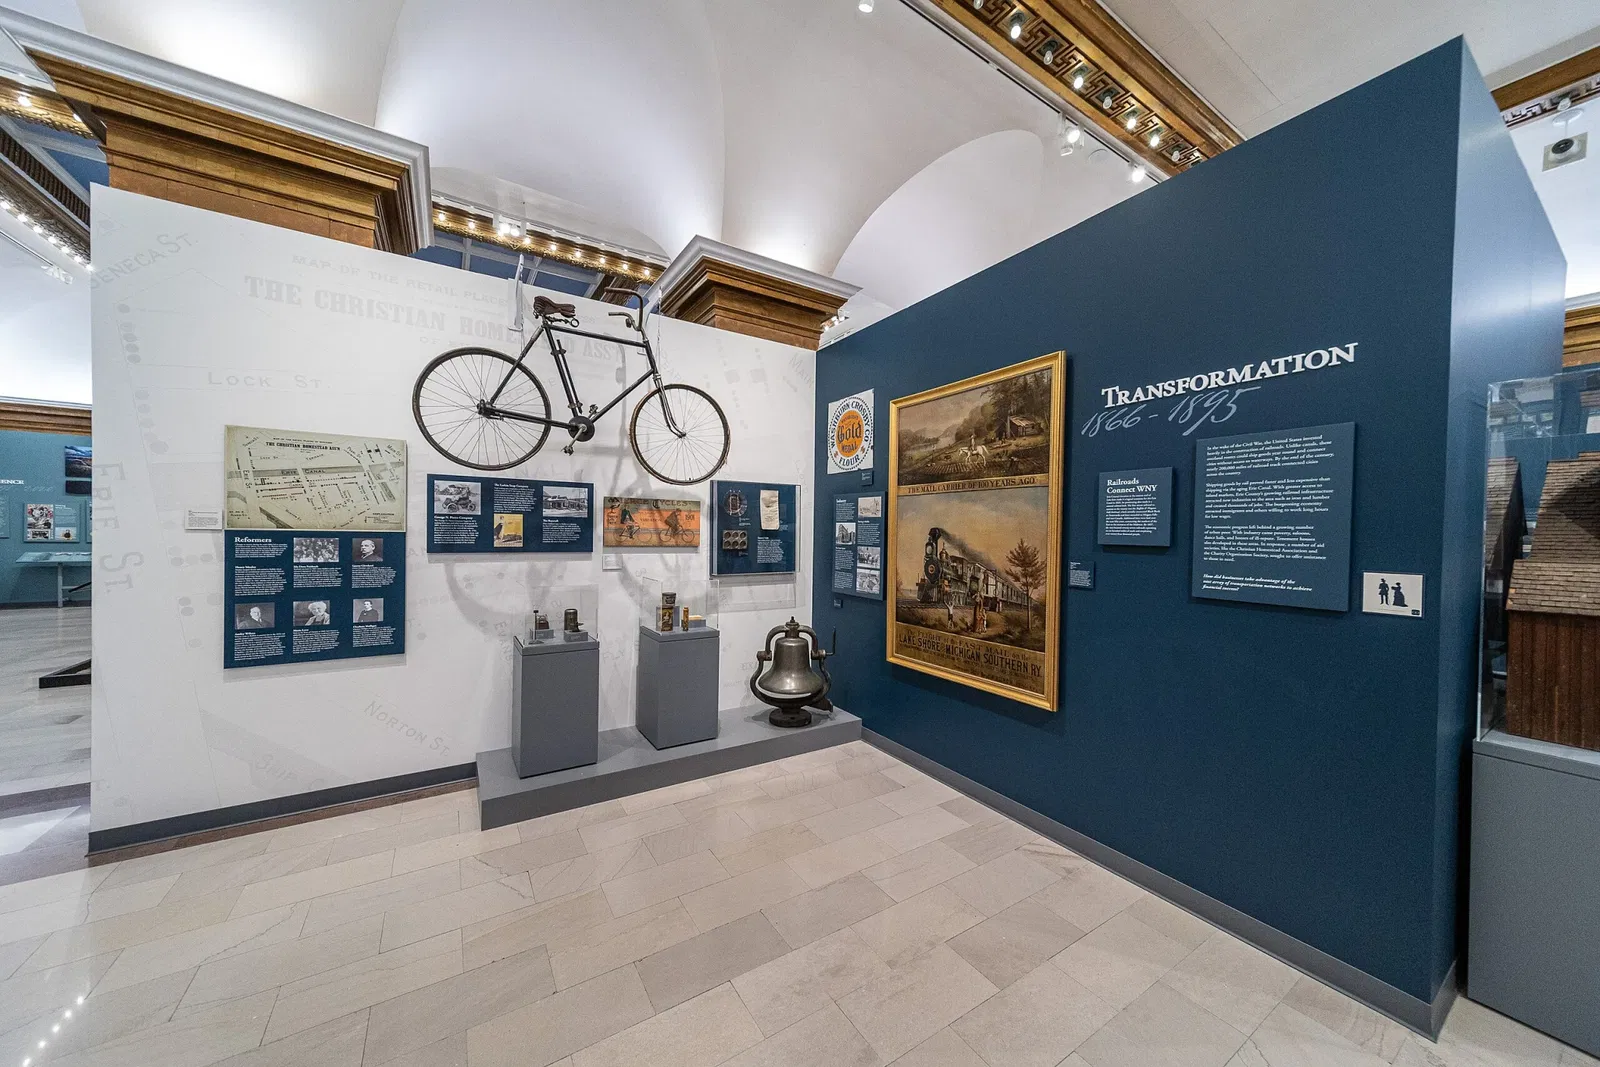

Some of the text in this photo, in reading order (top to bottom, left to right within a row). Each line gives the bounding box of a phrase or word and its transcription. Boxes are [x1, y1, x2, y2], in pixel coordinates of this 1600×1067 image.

[292, 254, 332, 272] MAP
[339, 264, 362, 277] OF
[369, 269, 399, 285] THE
[244, 274, 302, 307] THE
[314, 288, 445, 332] CHRISTIAN
[208, 372, 272, 388] LOCK
[1102, 342, 1358, 409] TRANSFORMATION
[830, 402, 850, 448] WASHBURN
[851, 401, 870, 427] CROSBY
[1080, 405, 1149, 438] 1866
[1168, 386, 1261, 436] 1895
[836, 420, 862, 444] Gold
[838, 454, 860, 467] FLOUR
[938, 483, 967, 491] CARRIER
[990, 478, 1016, 487] YEARS
[1107, 478, 1139, 486] Railroads
[899, 635, 917, 646] LAKE
[918, 638, 941, 651] SHORE
[945, 644, 981, 661] MICHIGAN
[984, 653, 1028, 673] SOUTHERN
[958, 640, 982, 650] FAST
[986, 646, 1009, 657] MAIL
[363, 699, 428, 746] NORTON
